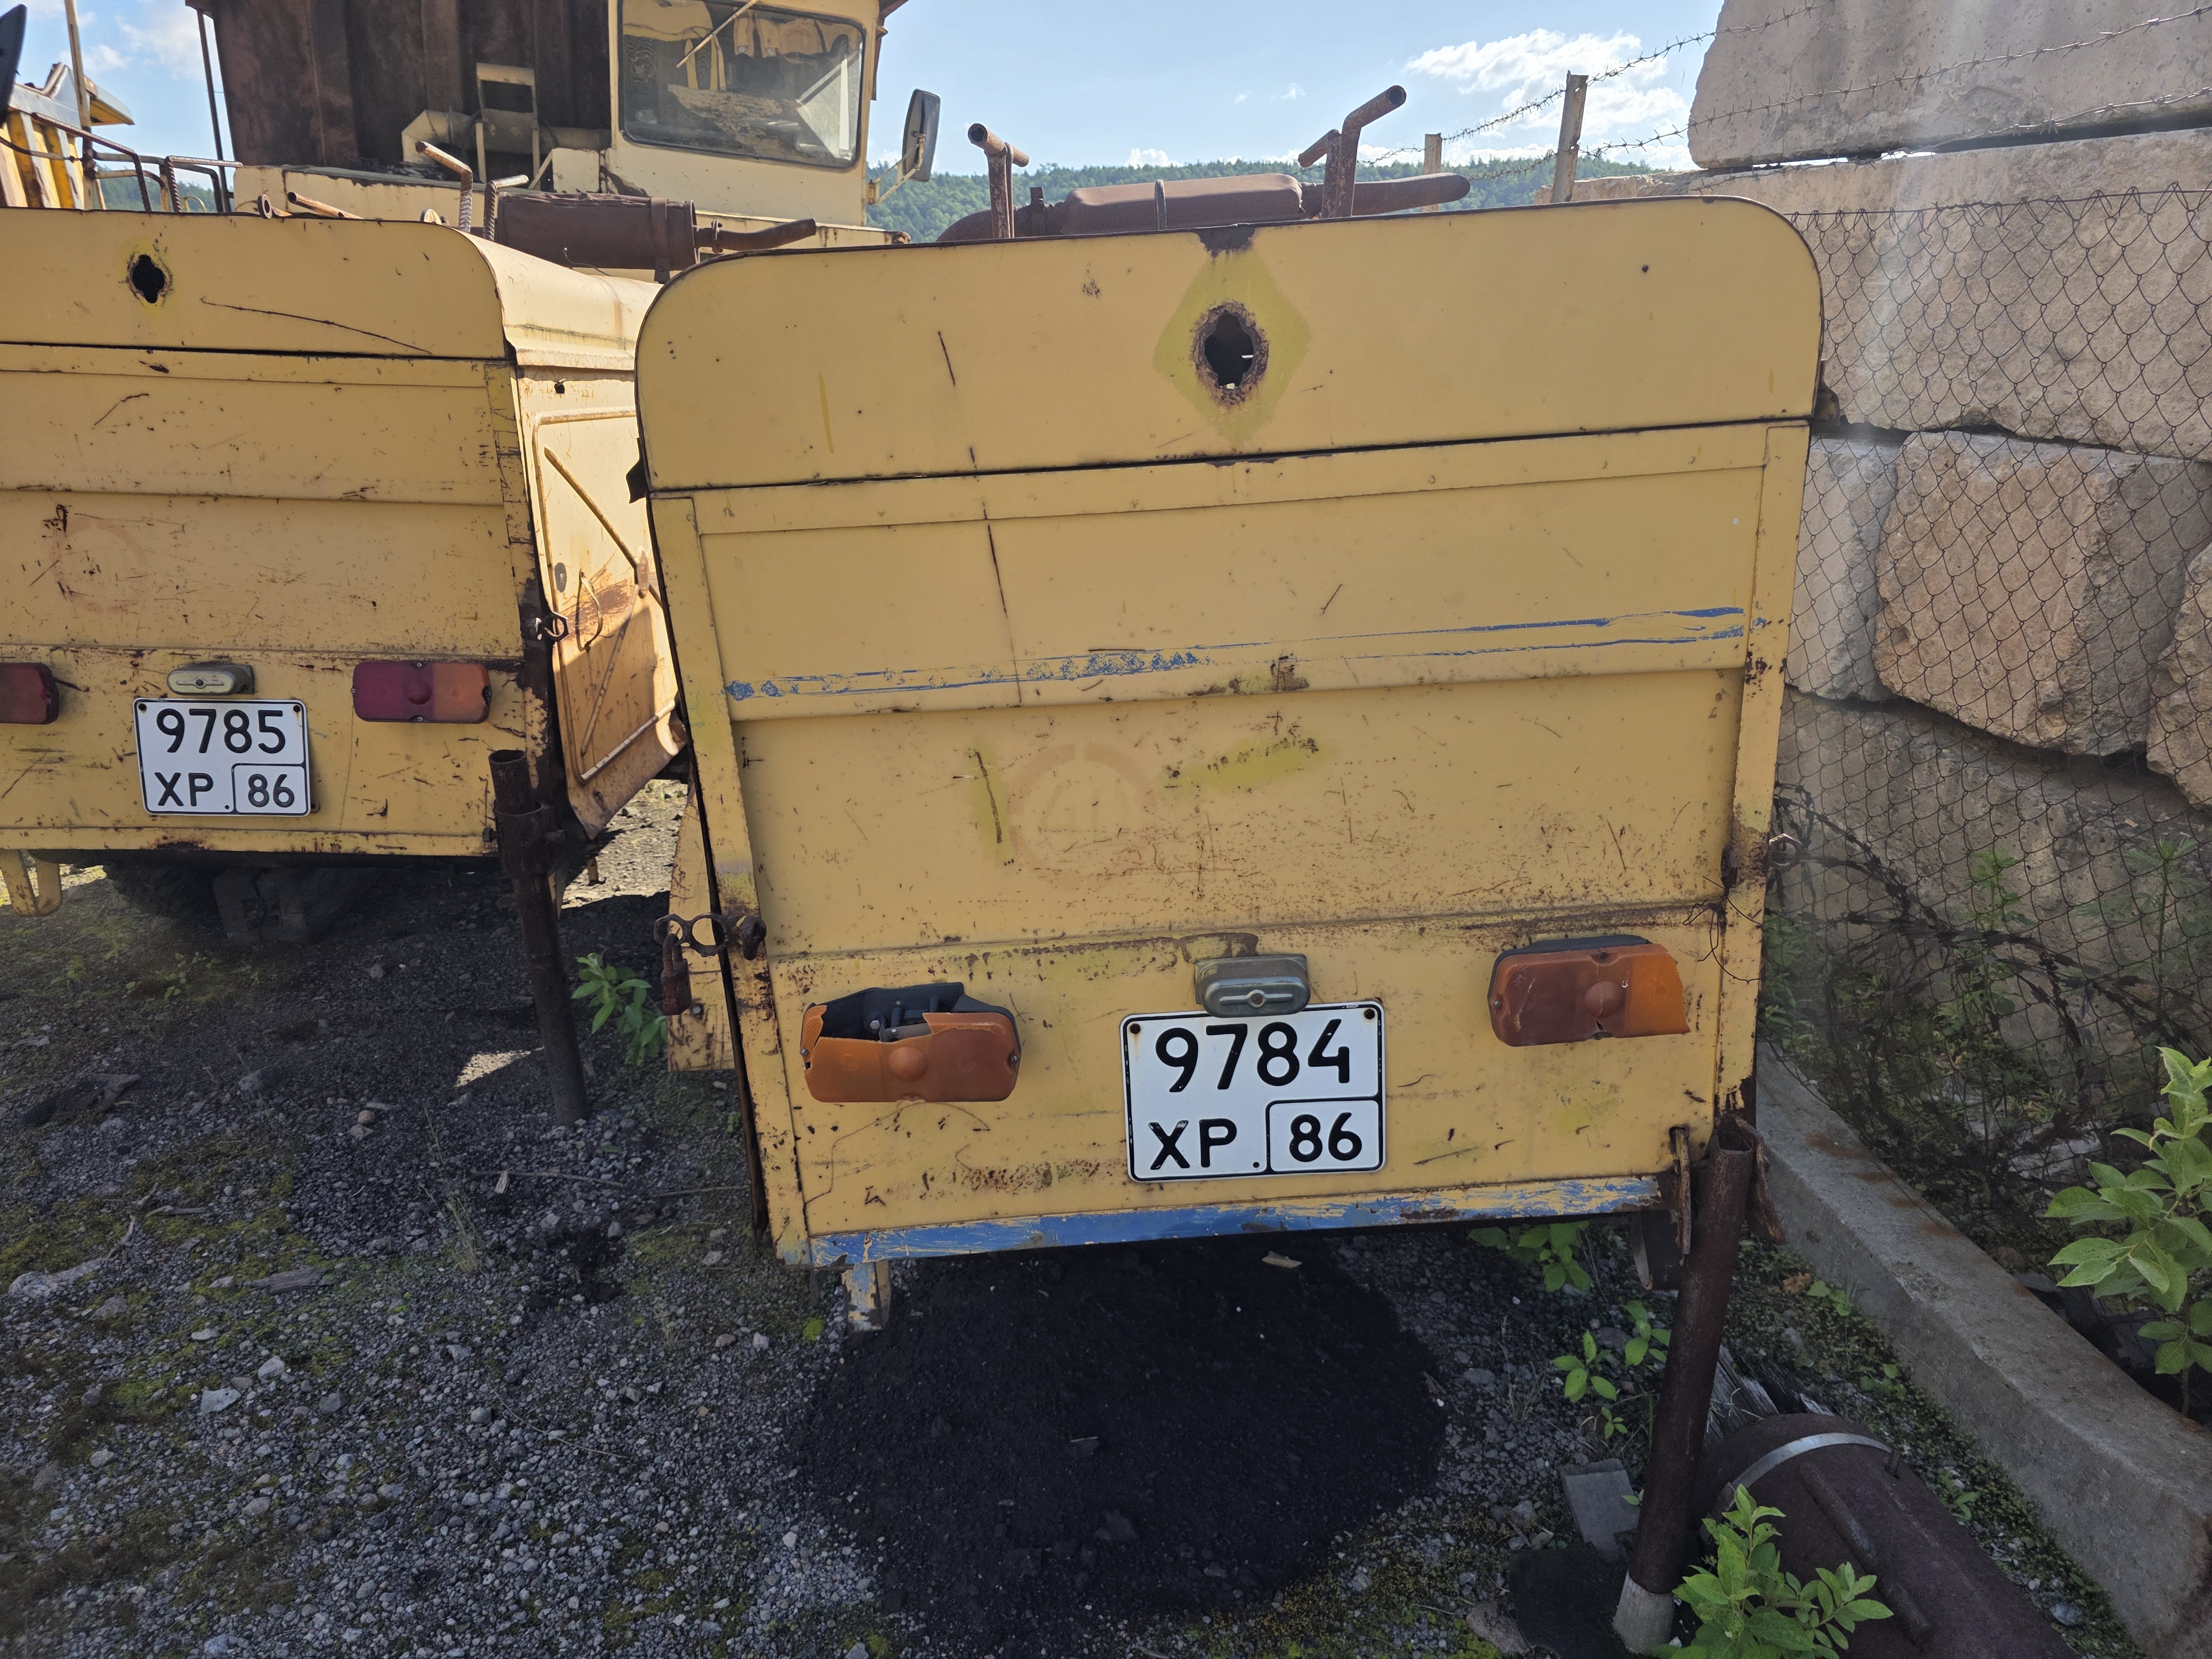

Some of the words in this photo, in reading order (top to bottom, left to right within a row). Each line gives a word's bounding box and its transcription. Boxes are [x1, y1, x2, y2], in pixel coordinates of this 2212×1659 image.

[156, 708, 286, 754] 9785
[154, 772, 214, 807] ХР
[248, 774, 295, 808] 86
[1155, 1019, 1350, 1093] 9784
[1148, 1119, 1237, 1170] ХР
[1289, 1112, 1363, 1162] 86
